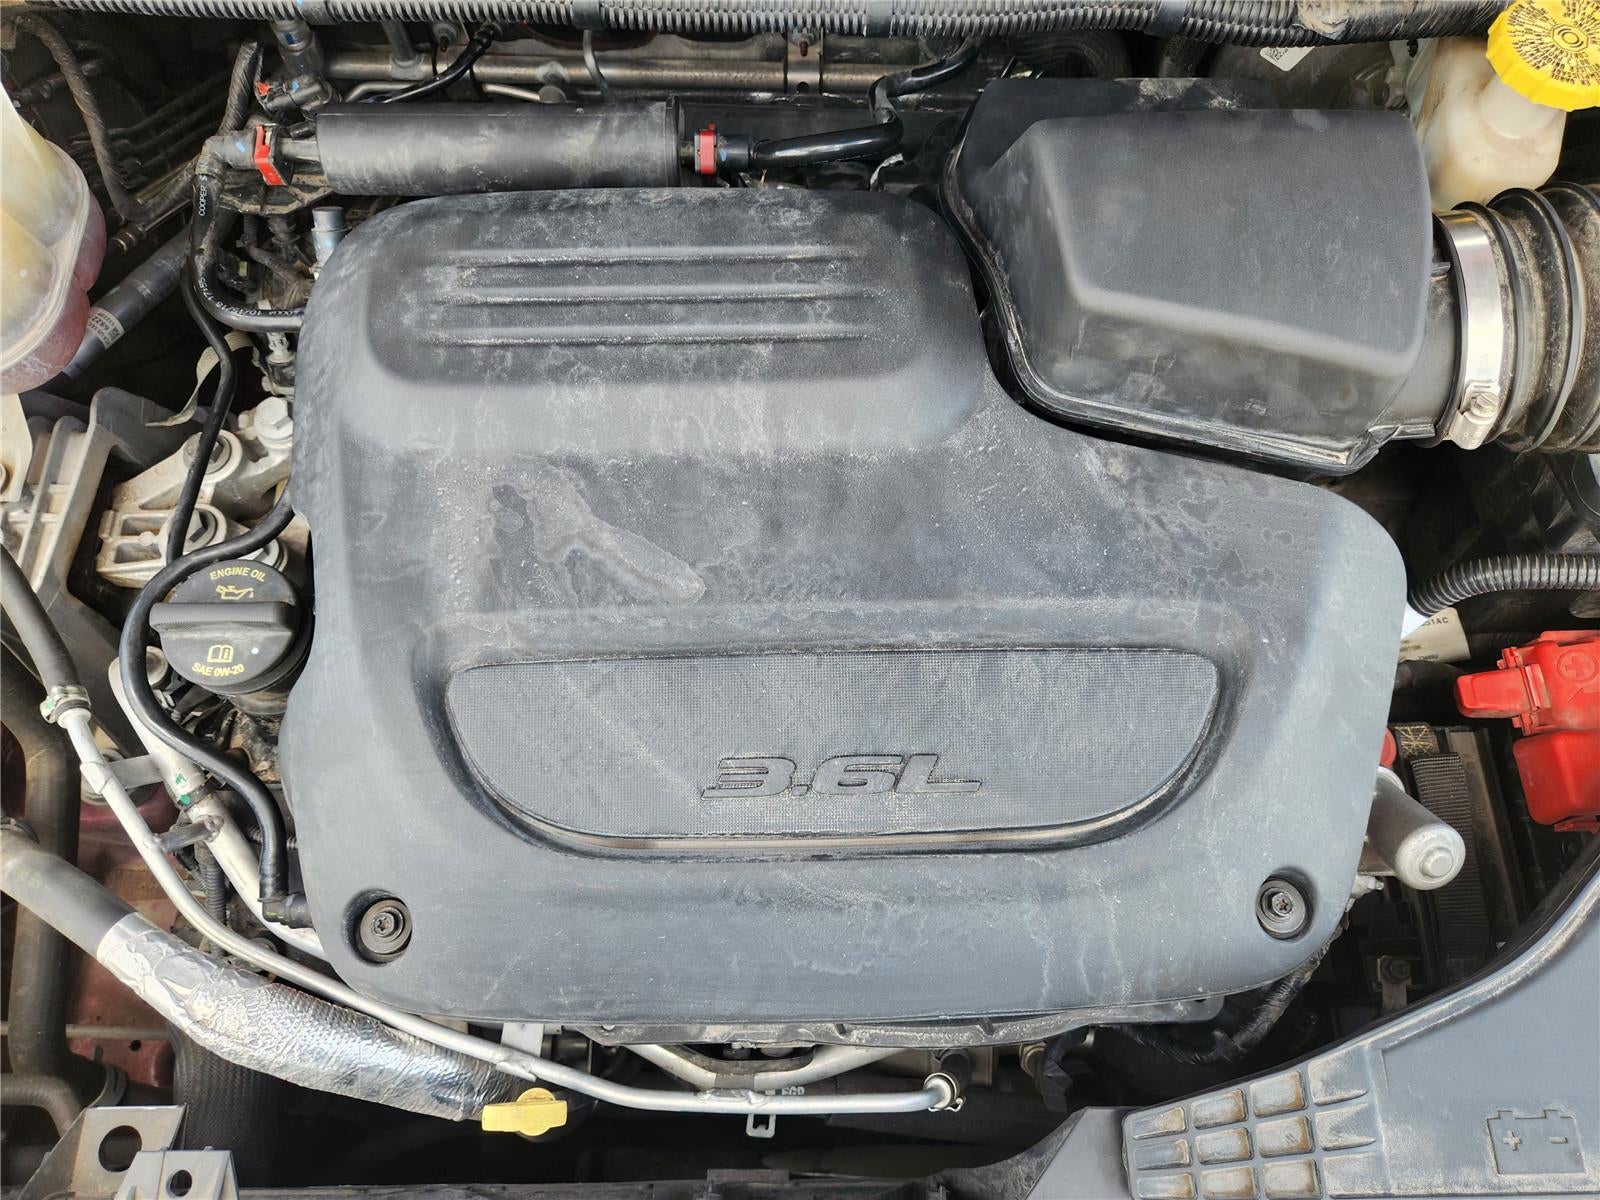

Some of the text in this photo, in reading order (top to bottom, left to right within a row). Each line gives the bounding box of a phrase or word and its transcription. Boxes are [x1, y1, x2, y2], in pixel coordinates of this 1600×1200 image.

[209, 566, 267, 582] ENGINE OIL
[191, 662, 245, 678] SAE 0W-20
[700, 753, 982, 799] 3.6L
